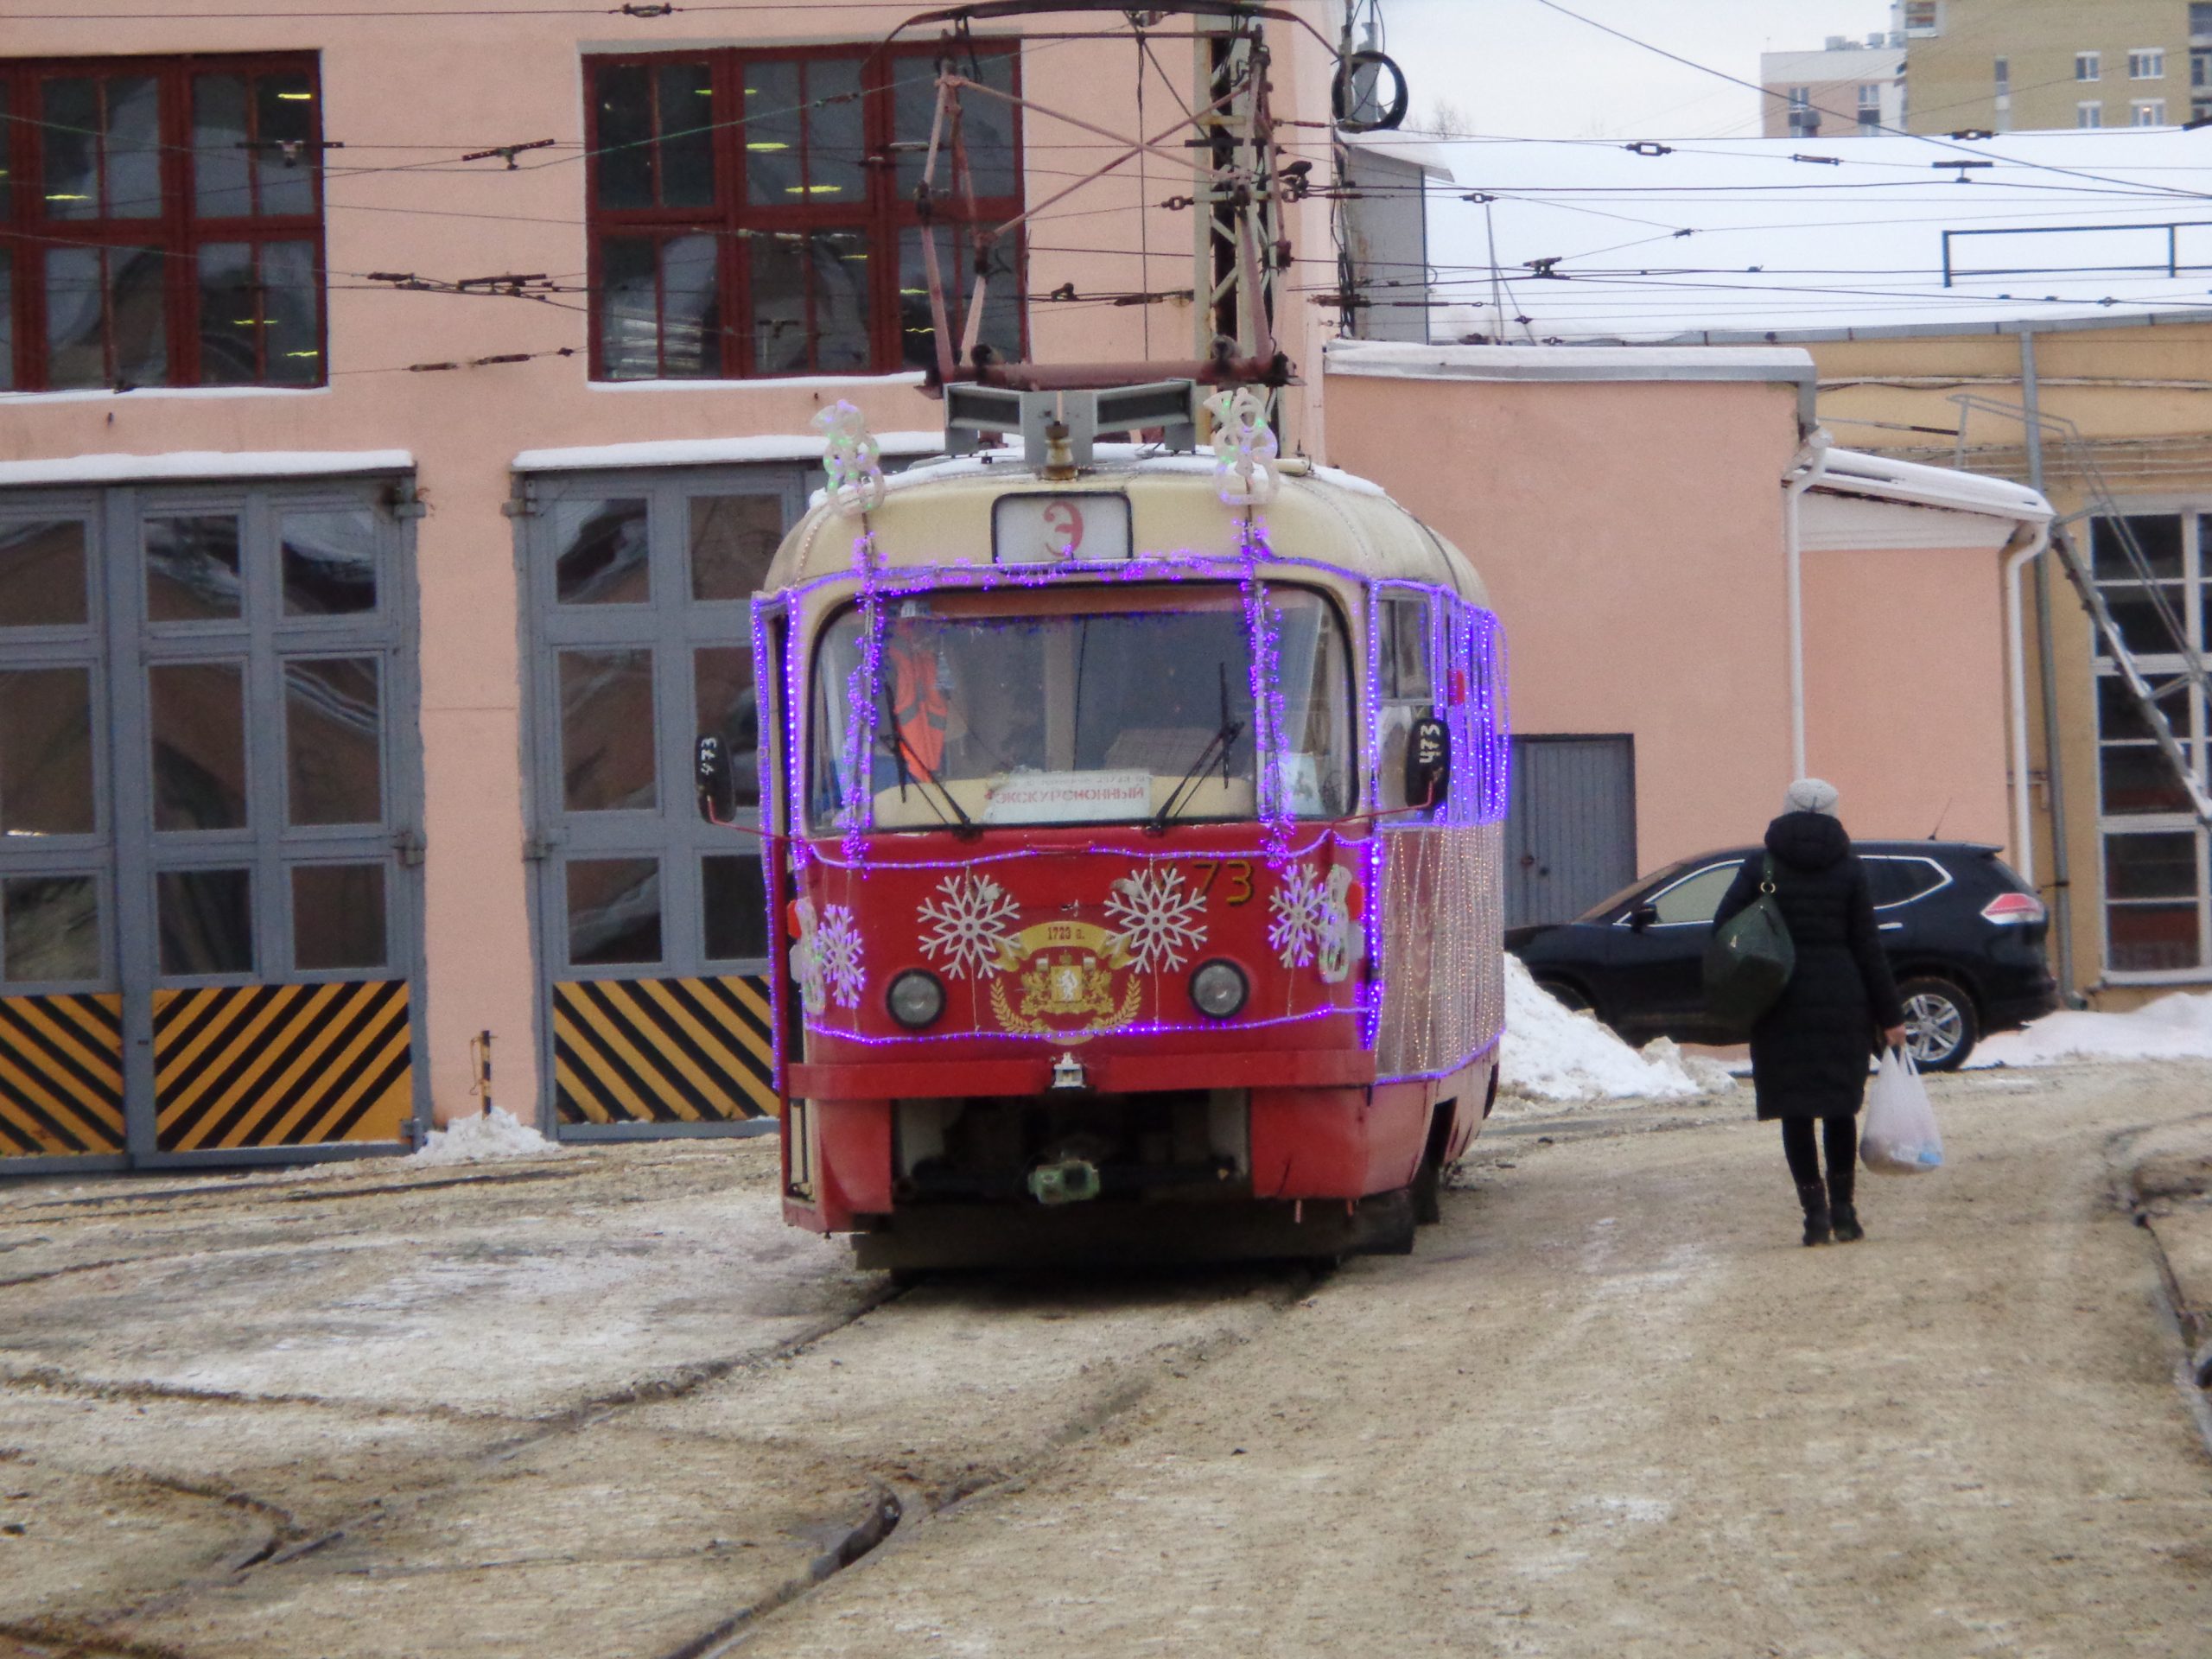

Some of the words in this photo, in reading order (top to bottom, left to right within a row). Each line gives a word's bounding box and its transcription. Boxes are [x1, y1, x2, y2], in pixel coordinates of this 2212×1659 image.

[1043, 500, 1084, 557] Э
[701, 737, 717, 776] 473
[1419, 723, 1441, 764] 473
[994, 784, 1145, 804] ЭКСКУРСИОННЫЙ
[1047, 926, 1071, 941] 1723
